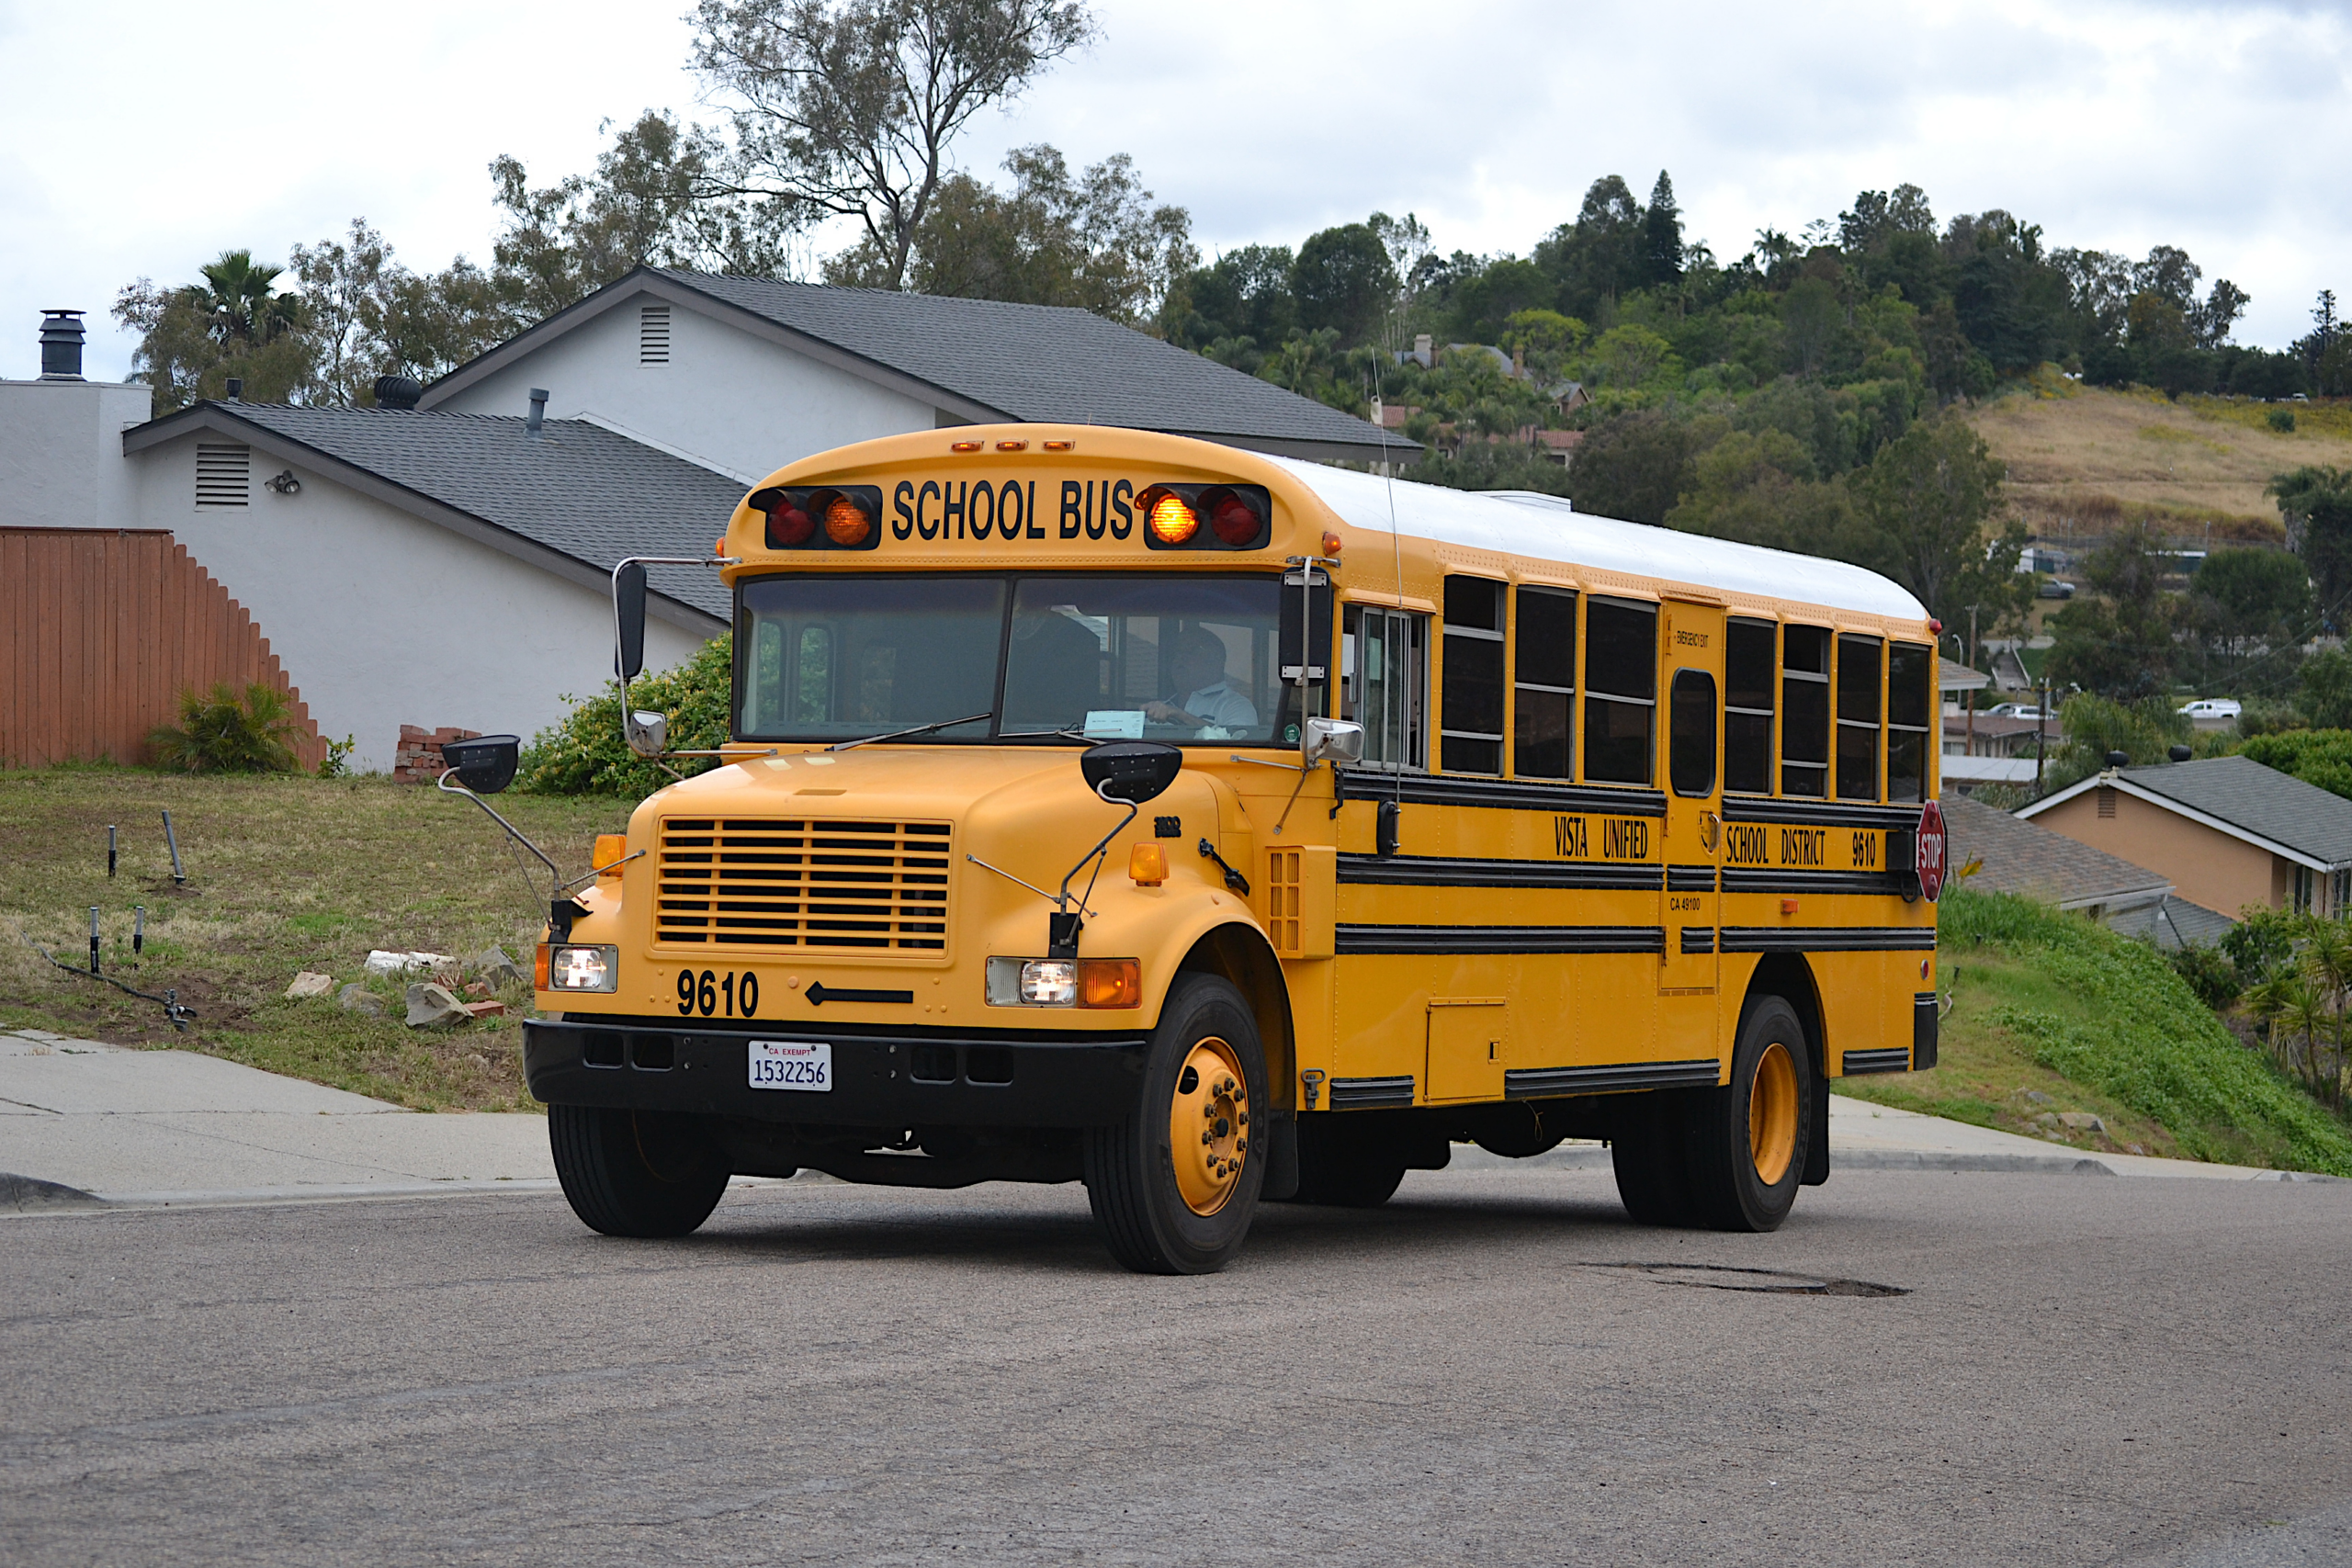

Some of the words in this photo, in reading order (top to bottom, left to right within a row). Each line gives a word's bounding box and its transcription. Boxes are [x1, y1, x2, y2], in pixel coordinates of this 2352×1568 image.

[891, 479, 1046, 541] SCHOOL
[1058, 479, 1134, 541] BUS
[1677, 630, 1698, 647] EMERGENCY
[1700, 634, 1709, 648] EXIT
[1554, 816, 1589, 858] VISTA
[1603, 818, 1648, 860] UNIFIED
[1726, 825, 1770, 865] SCHOOL
[1781, 828, 1826, 866] DISTRICT
[1852, 831, 1876, 867] 9610
[1921, 833, 1942, 869] STOP
[1670, 897, 1679, 910] CA
[1681, 897, 1701, 910] 49100
[676, 968, 759, 1018] 9610
[782, 1048, 810, 1056] EXEMPT
[754, 1059, 825, 1084] 1532256
